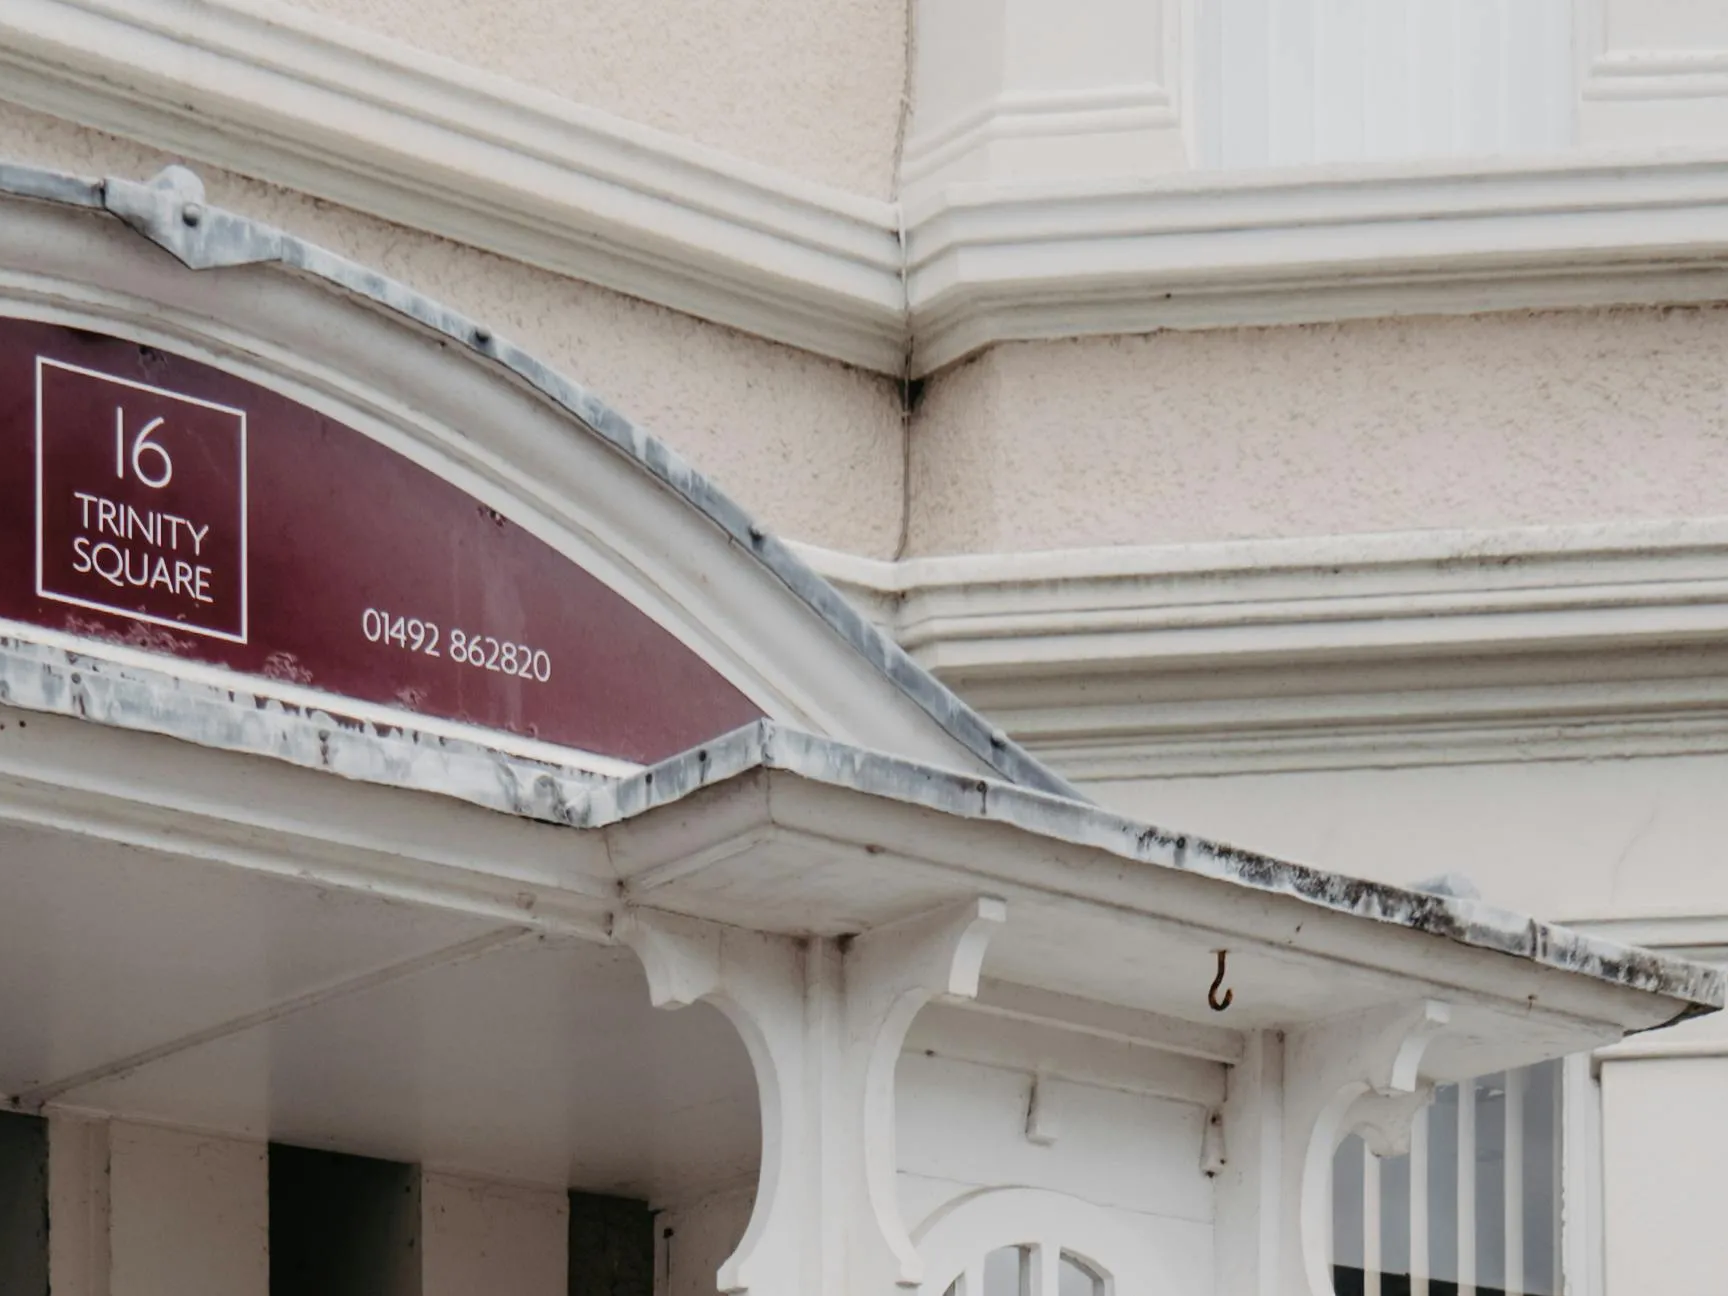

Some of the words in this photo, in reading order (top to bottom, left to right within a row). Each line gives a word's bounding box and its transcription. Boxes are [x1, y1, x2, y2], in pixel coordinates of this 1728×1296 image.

[116, 405, 172, 489] 16
[73, 491, 210, 557] TRINITY
[72, 536, 214, 603] SQUARE
[362, 607, 441, 658] 01492
[449, 628, 552, 682] 862820
